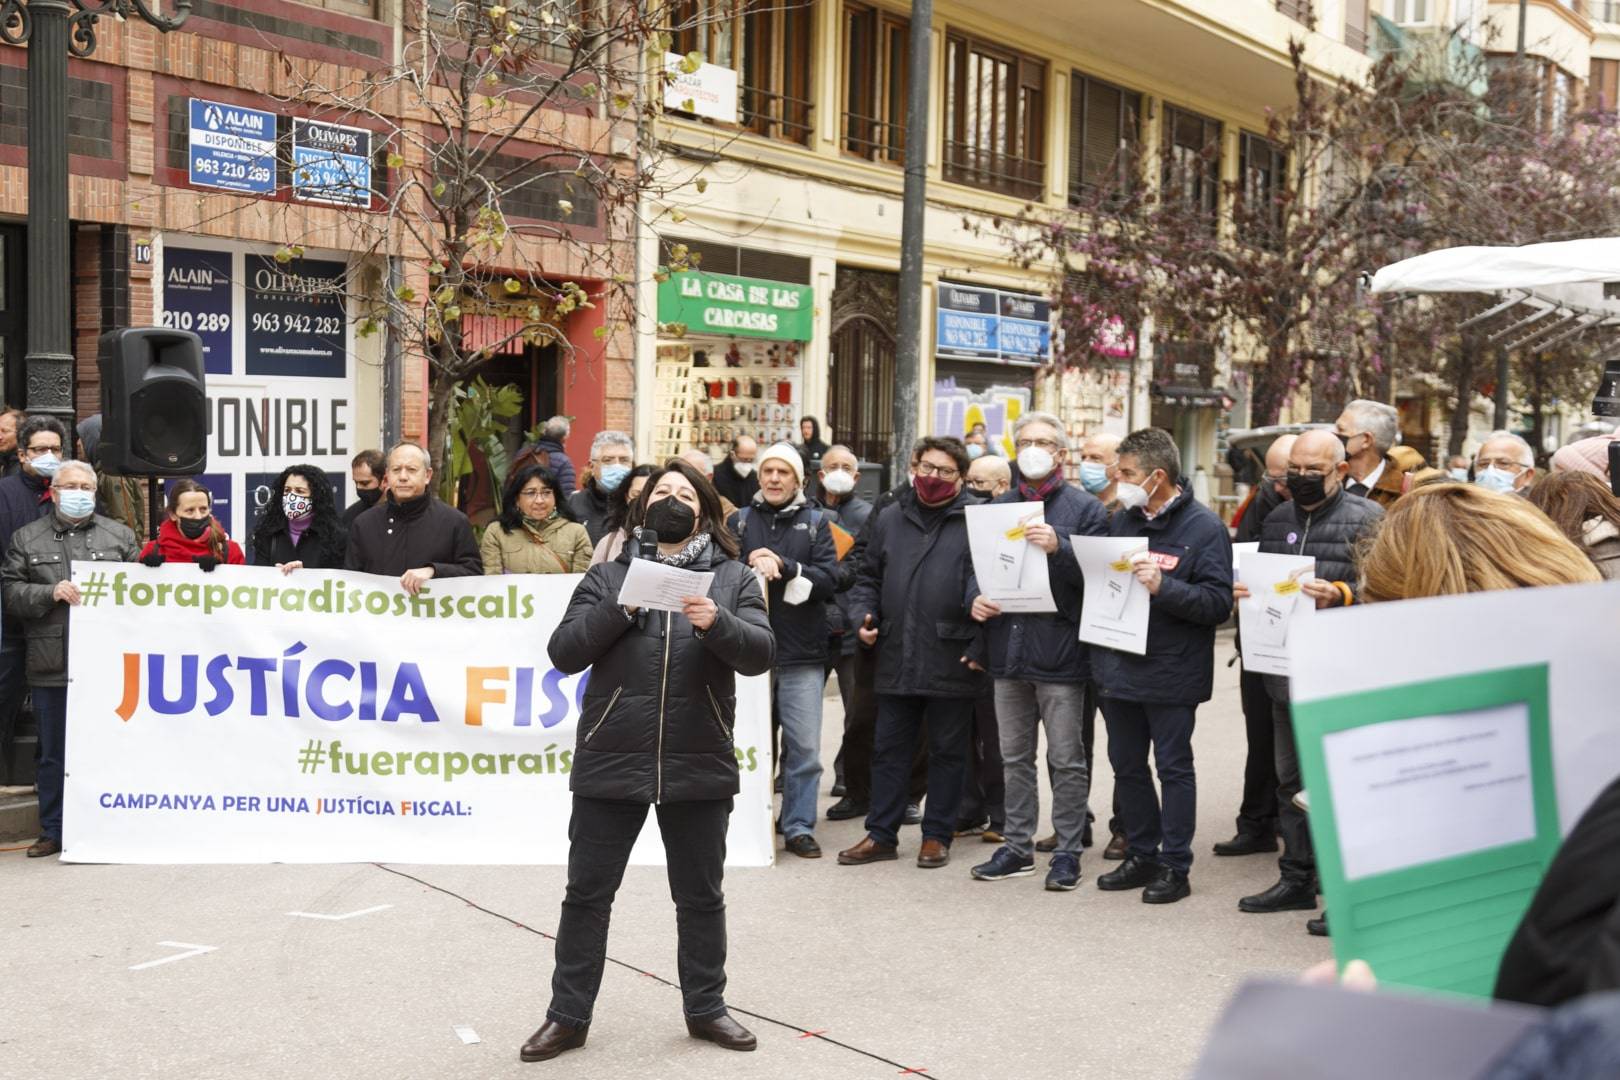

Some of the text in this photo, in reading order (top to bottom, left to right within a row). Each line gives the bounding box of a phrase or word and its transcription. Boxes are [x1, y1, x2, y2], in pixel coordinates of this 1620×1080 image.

[225, 110, 263, 130] ALAIN
[205, 134, 263, 153] DISPONIBLE
[308, 125, 358, 147] OLIVARES
[195, 157, 219, 175] 963
[222, 161, 245, 179] 210
[248, 165, 271, 183] 289
[137, 246, 150, 262] 10
[168, 267, 213, 285] ALAIN
[255, 269, 334, 295] OLIVARES
[681, 277, 800, 309] LA CASA DE LAS
[163, 310, 230, 332] 210 289
[252, 312, 341, 334] 963 942 282
[704, 307, 778, 332] CARCASAS
[114, 640, 592, 729] JUSTÍCIA FIS
[99, 792, 472, 817] CAMPANYA PER UNA JUSTÍCIA FISCAL:
